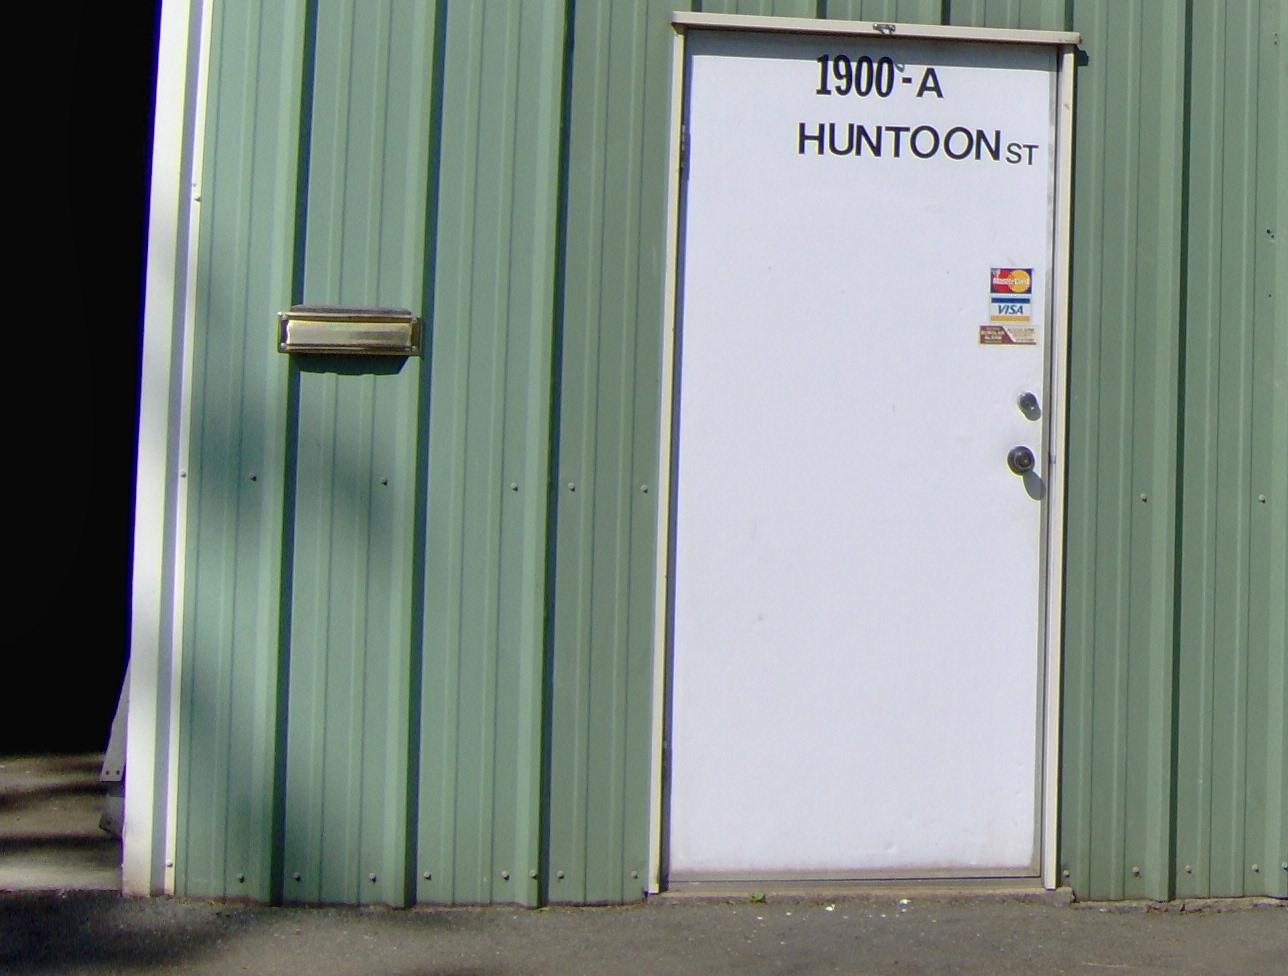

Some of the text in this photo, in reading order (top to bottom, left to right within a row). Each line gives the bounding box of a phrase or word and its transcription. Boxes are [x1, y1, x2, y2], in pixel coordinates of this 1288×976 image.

[798, 122, 1039, 166] HUNTOON ST
[997, 304, 1023, 315] VISA
